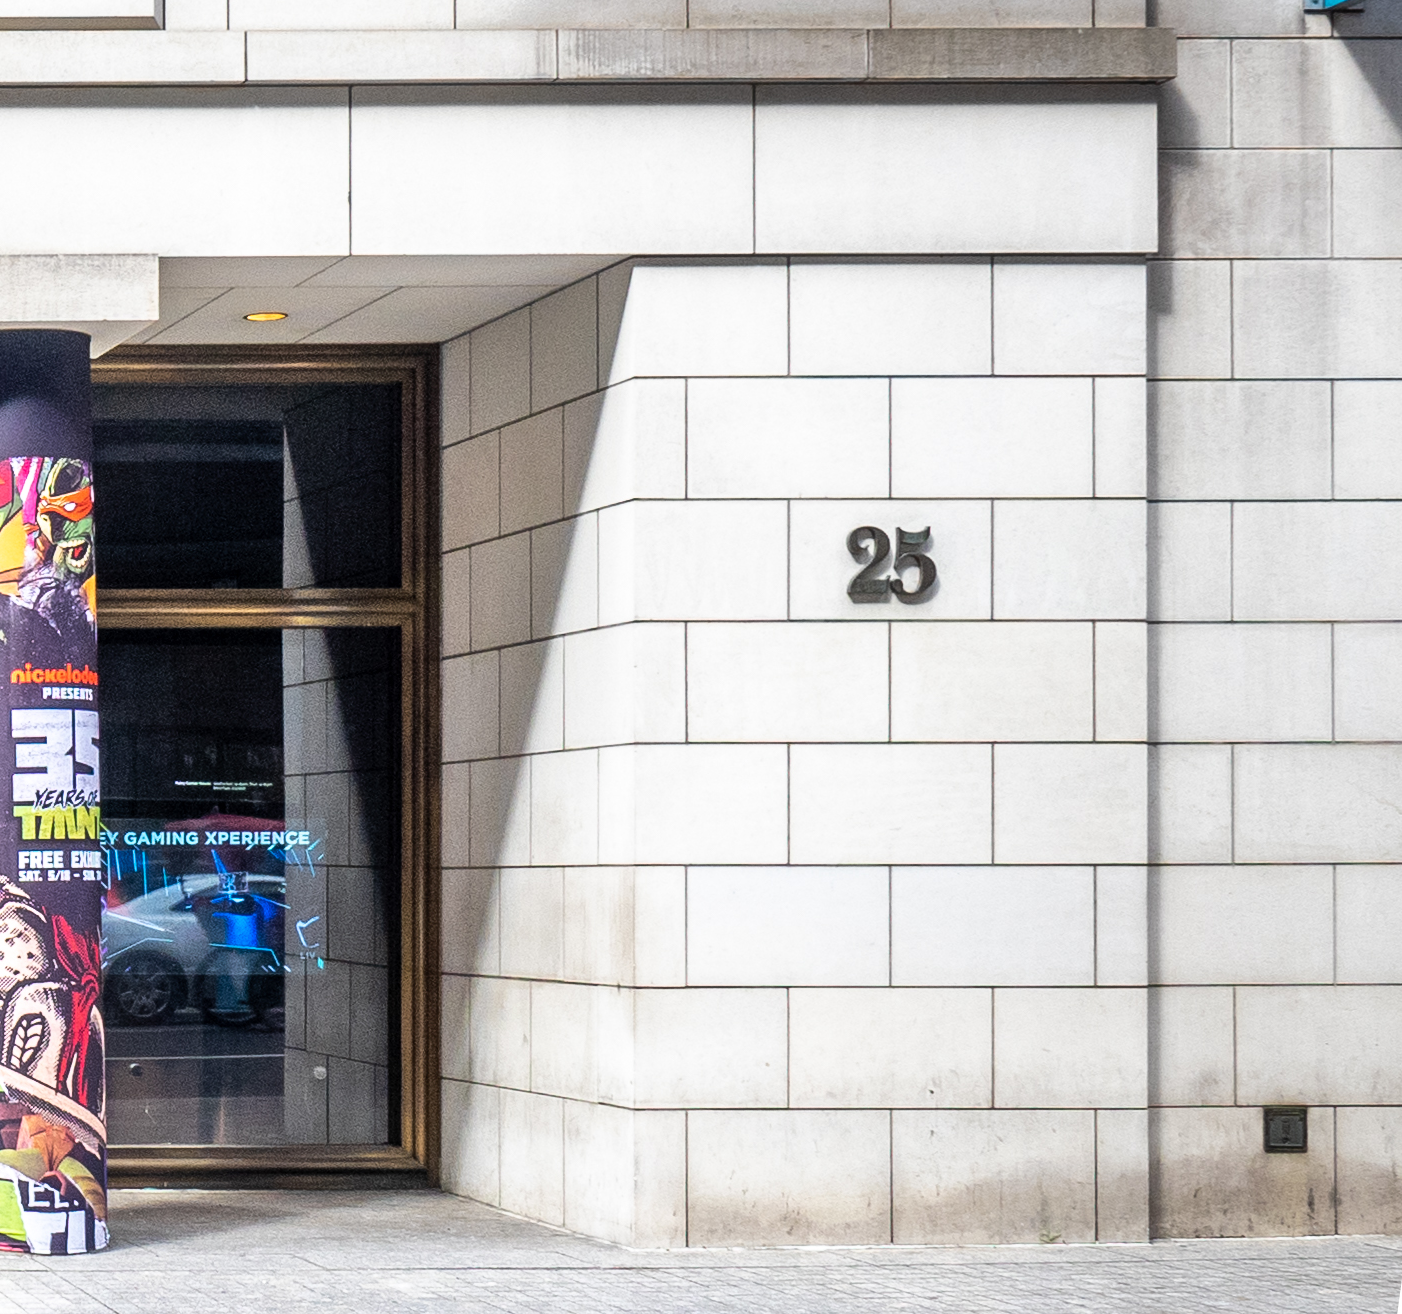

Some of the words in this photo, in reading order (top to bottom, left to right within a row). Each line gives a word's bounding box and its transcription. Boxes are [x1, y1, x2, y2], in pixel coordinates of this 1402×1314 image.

[847, 526, 939, 604] 25
[42, 687, 93, 701] PRESENTS
[34, 788, 84, 809] YEARS
[124, 831, 199, 846] GAMING
[205, 831, 310, 846] XPERIENCE
[18, 851, 64, 869] FREE
[19, 870, 43, 882] SAT.
